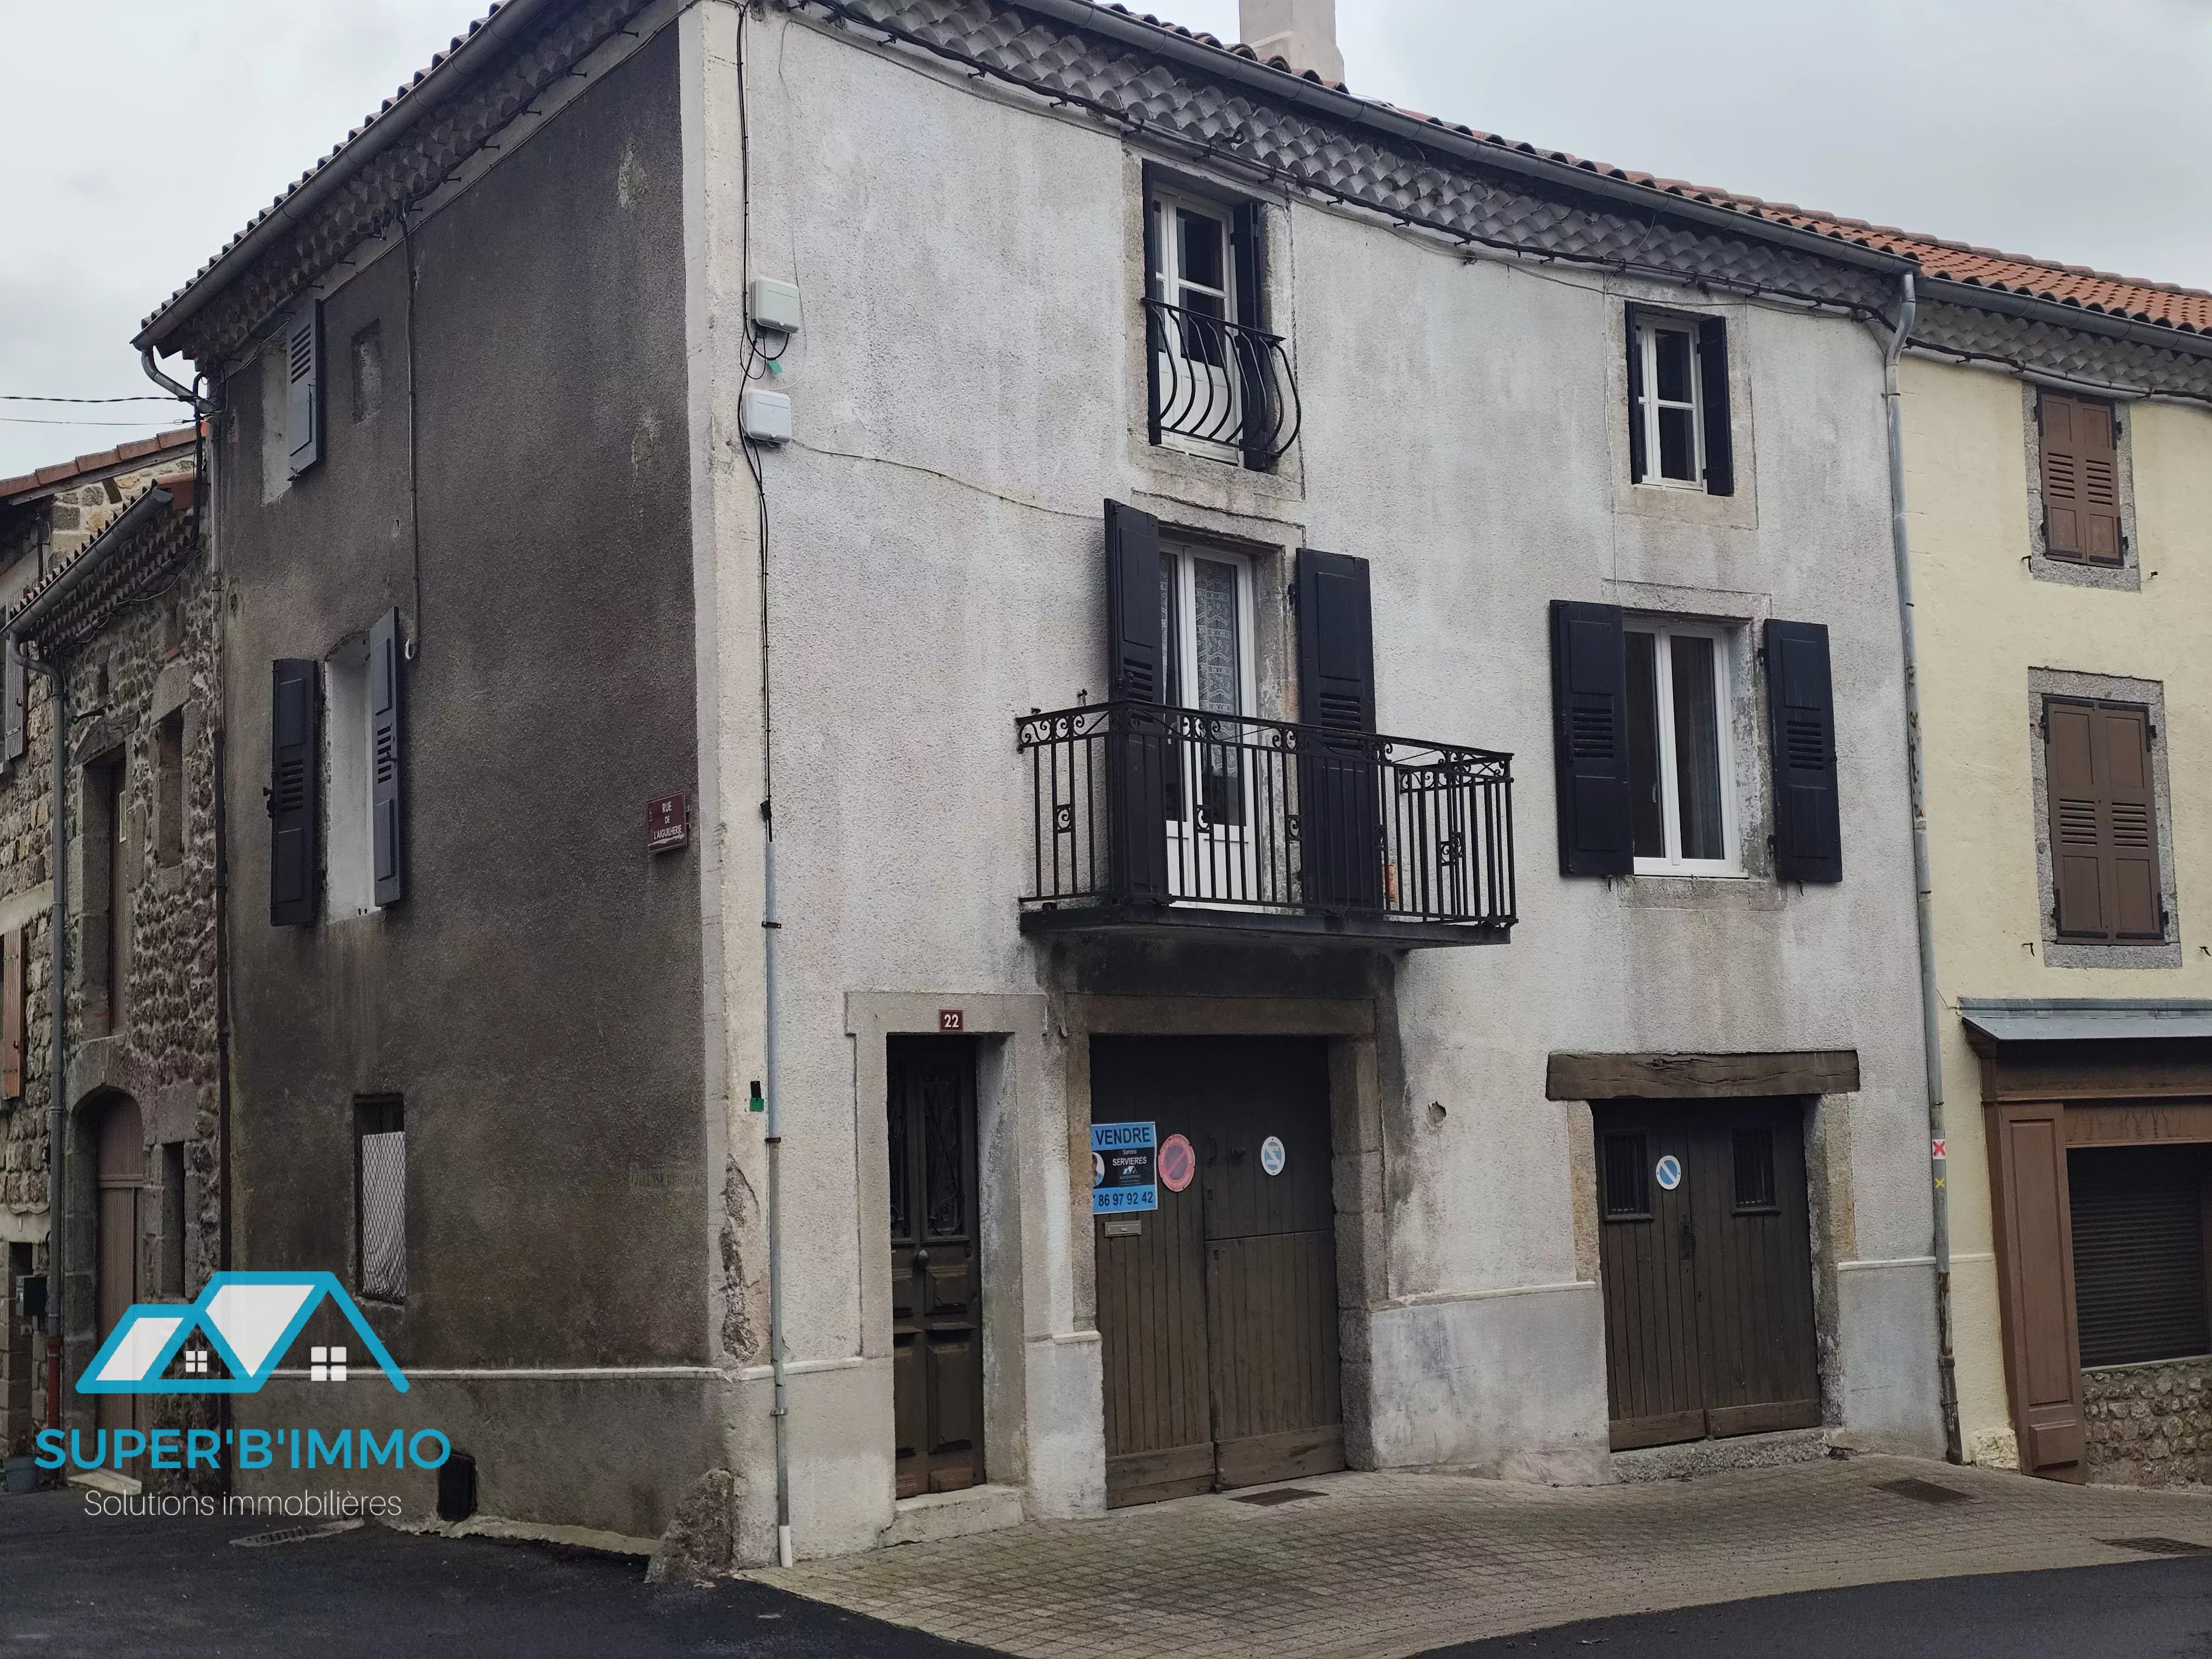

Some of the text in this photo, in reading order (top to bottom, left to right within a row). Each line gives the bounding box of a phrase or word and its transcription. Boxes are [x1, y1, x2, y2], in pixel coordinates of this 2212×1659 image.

[662, 801, 672, 813] RUE
[664, 815, 671, 824] DE
[944, 1014, 959, 1028] 22
[1095, 1127, 1151, 1146] VENDRE
[1113, 1156, 1147, 1166] SERVIERES
[1098, 1191, 1153, 1207] 86 97 92 42
